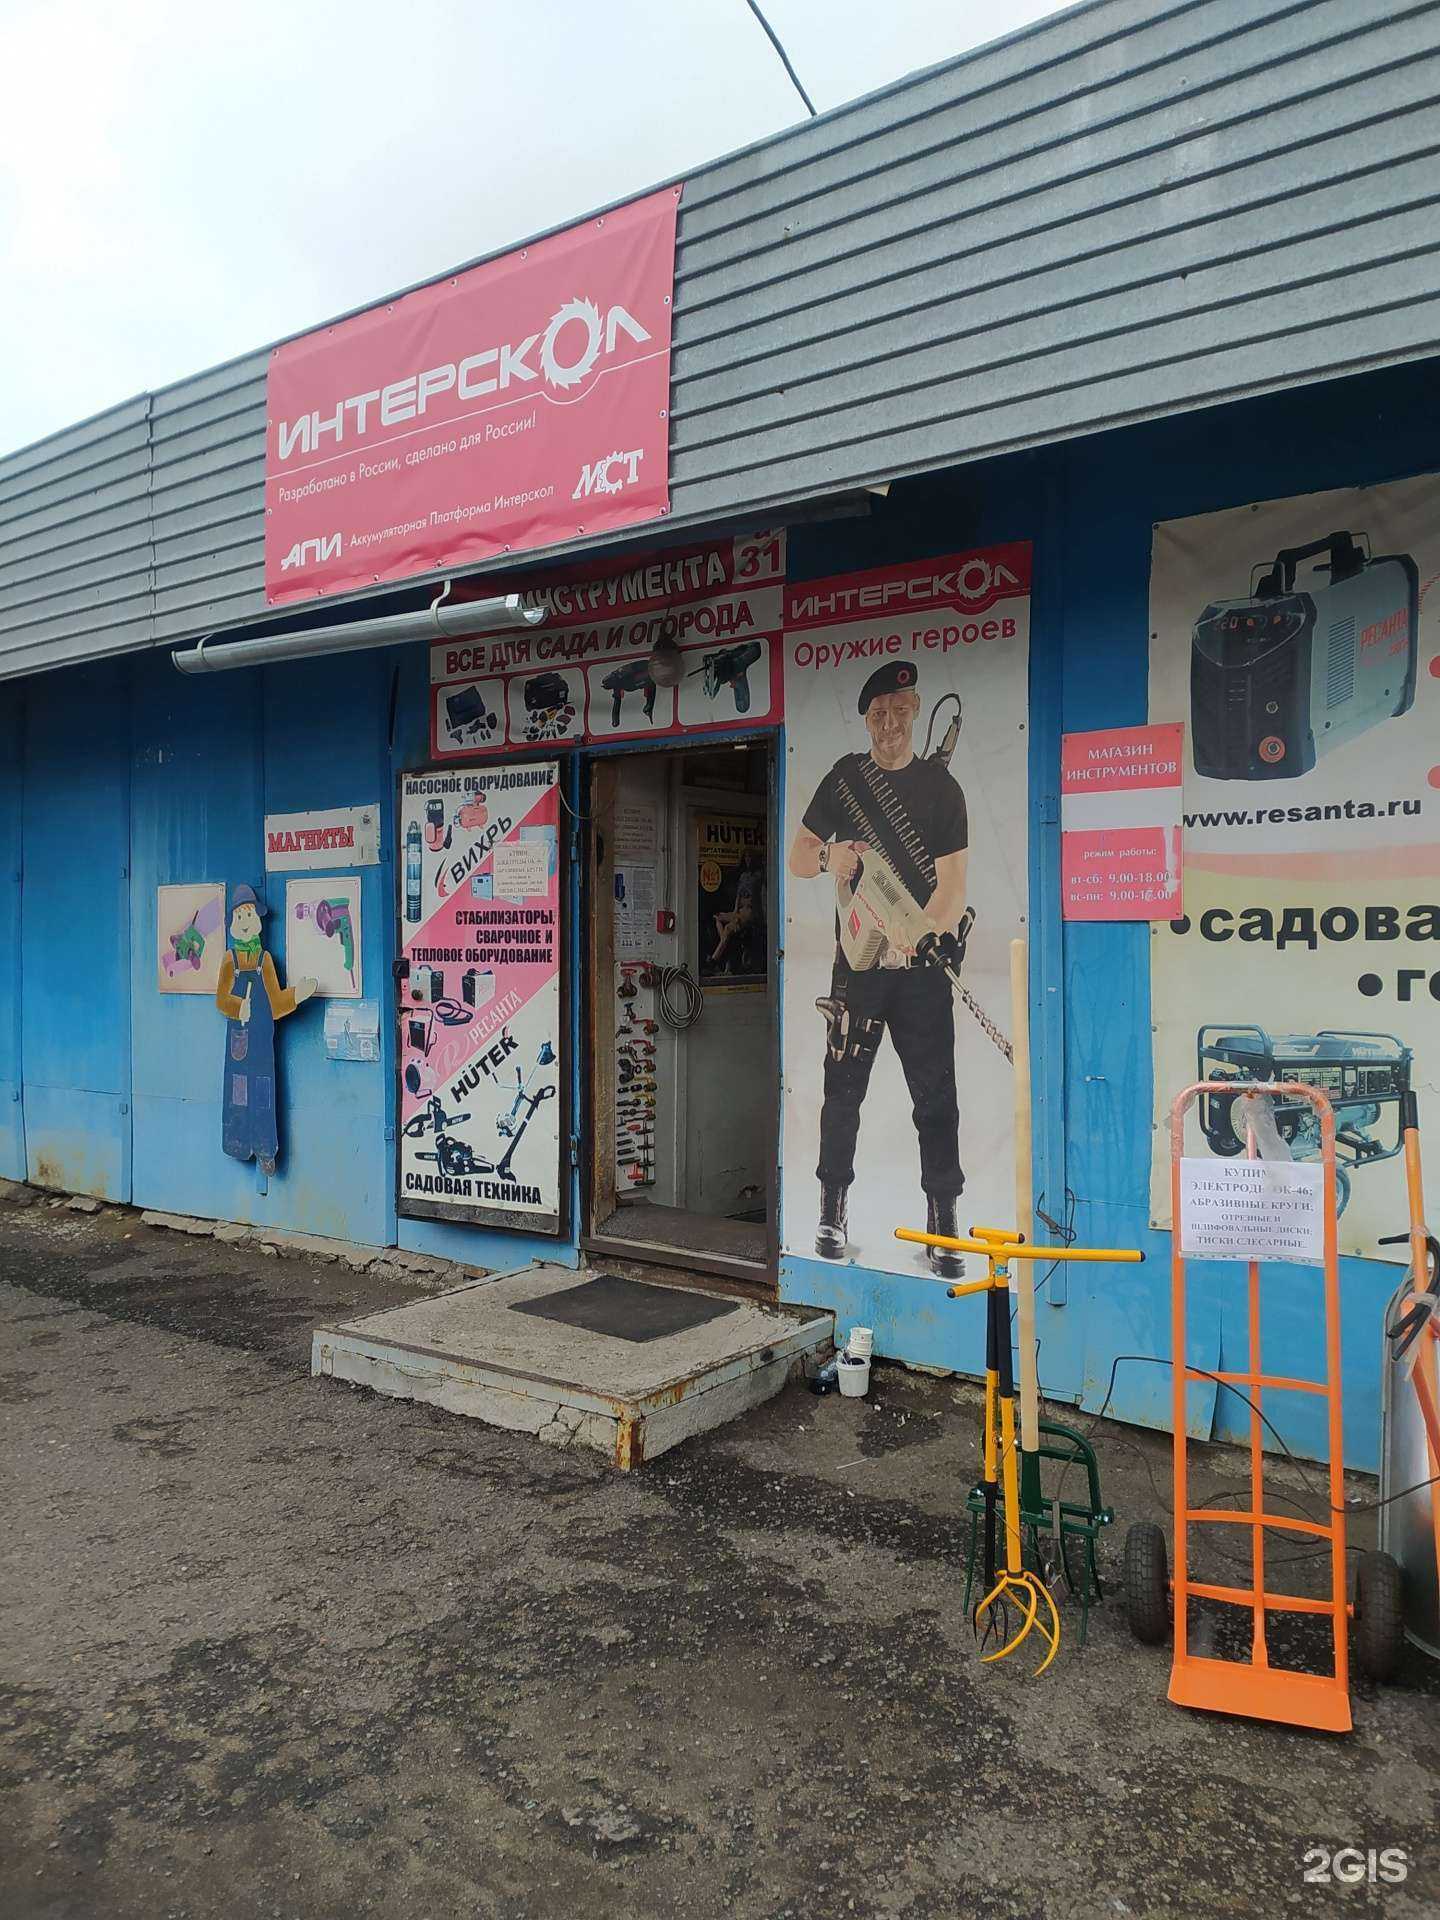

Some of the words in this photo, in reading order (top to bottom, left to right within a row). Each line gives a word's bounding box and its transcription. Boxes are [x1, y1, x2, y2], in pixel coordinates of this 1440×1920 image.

[279, 296, 652, 460] ИНТЕРСКОЛ
[279, 473, 347, 502] Разработано
[349, 473, 356, 483] в
[359, 459, 401, 480] России,
[405, 440, 457, 466] сделано
[459, 433, 481, 451] для
[485, 410, 537, 441] России!
[572, 449, 643, 500] МСТ
[350, 518, 427, 548] Аккумуляторная
[430, 502, 491, 526] Платформа
[494, 486, 555, 510] Интерскол
[280, 532, 342, 571] АПИ
[739, 540, 780, 578] 31
[791, 558, 1019, 619] ИНТЕРСКОЛ
[446, 647, 485, 675] ВСЕ
[489, 639, 531, 672] ДЛЯ
[536, 630, 600, 660] САДА
[605, 625, 623, 649] И
[629, 600, 755, 646] ОГОРОДА
[794, 635, 902, 670] Оружие
[912, 618, 1016, 651] героев
[1067, 761, 1176, 781] ИНСТРУМЕНТОВ
[1088, 743, 1153, 760] МАГАЗИН
[405, 776, 462, 796] НАСОСНОЕ
[463, 769, 554, 793] ОБОРУДОВАНИЕ
[1183, 799, 1421, 828] www.resanta.ru
[268, 826, 355, 854] МАГНИТЫ
[449, 815, 513, 885] ВИХРЬ
[1084, 849, 1115, 861] режим
[1119, 848, 1158, 860] работы:
[455, 910, 555, 927] СТАБИЛИЗАТОРЫ,
[476, 930, 541, 945] СВАРОЧНОЕ
[545, 930, 553, 943] И
[1200, 905, 1440, 950] садова
[411, 947, 462, 963] ТЕПЛОВОЕ
[465, 948, 553, 965] ОБОРУДОВАНИЕ
[468, 989, 524, 1046] РЕСАНТА
[450, 1036, 519, 1103] HÜTER
[405, 1172, 471, 1197] САДОВАЯ
[475, 1179, 542, 1205] ТЕХНИКА
